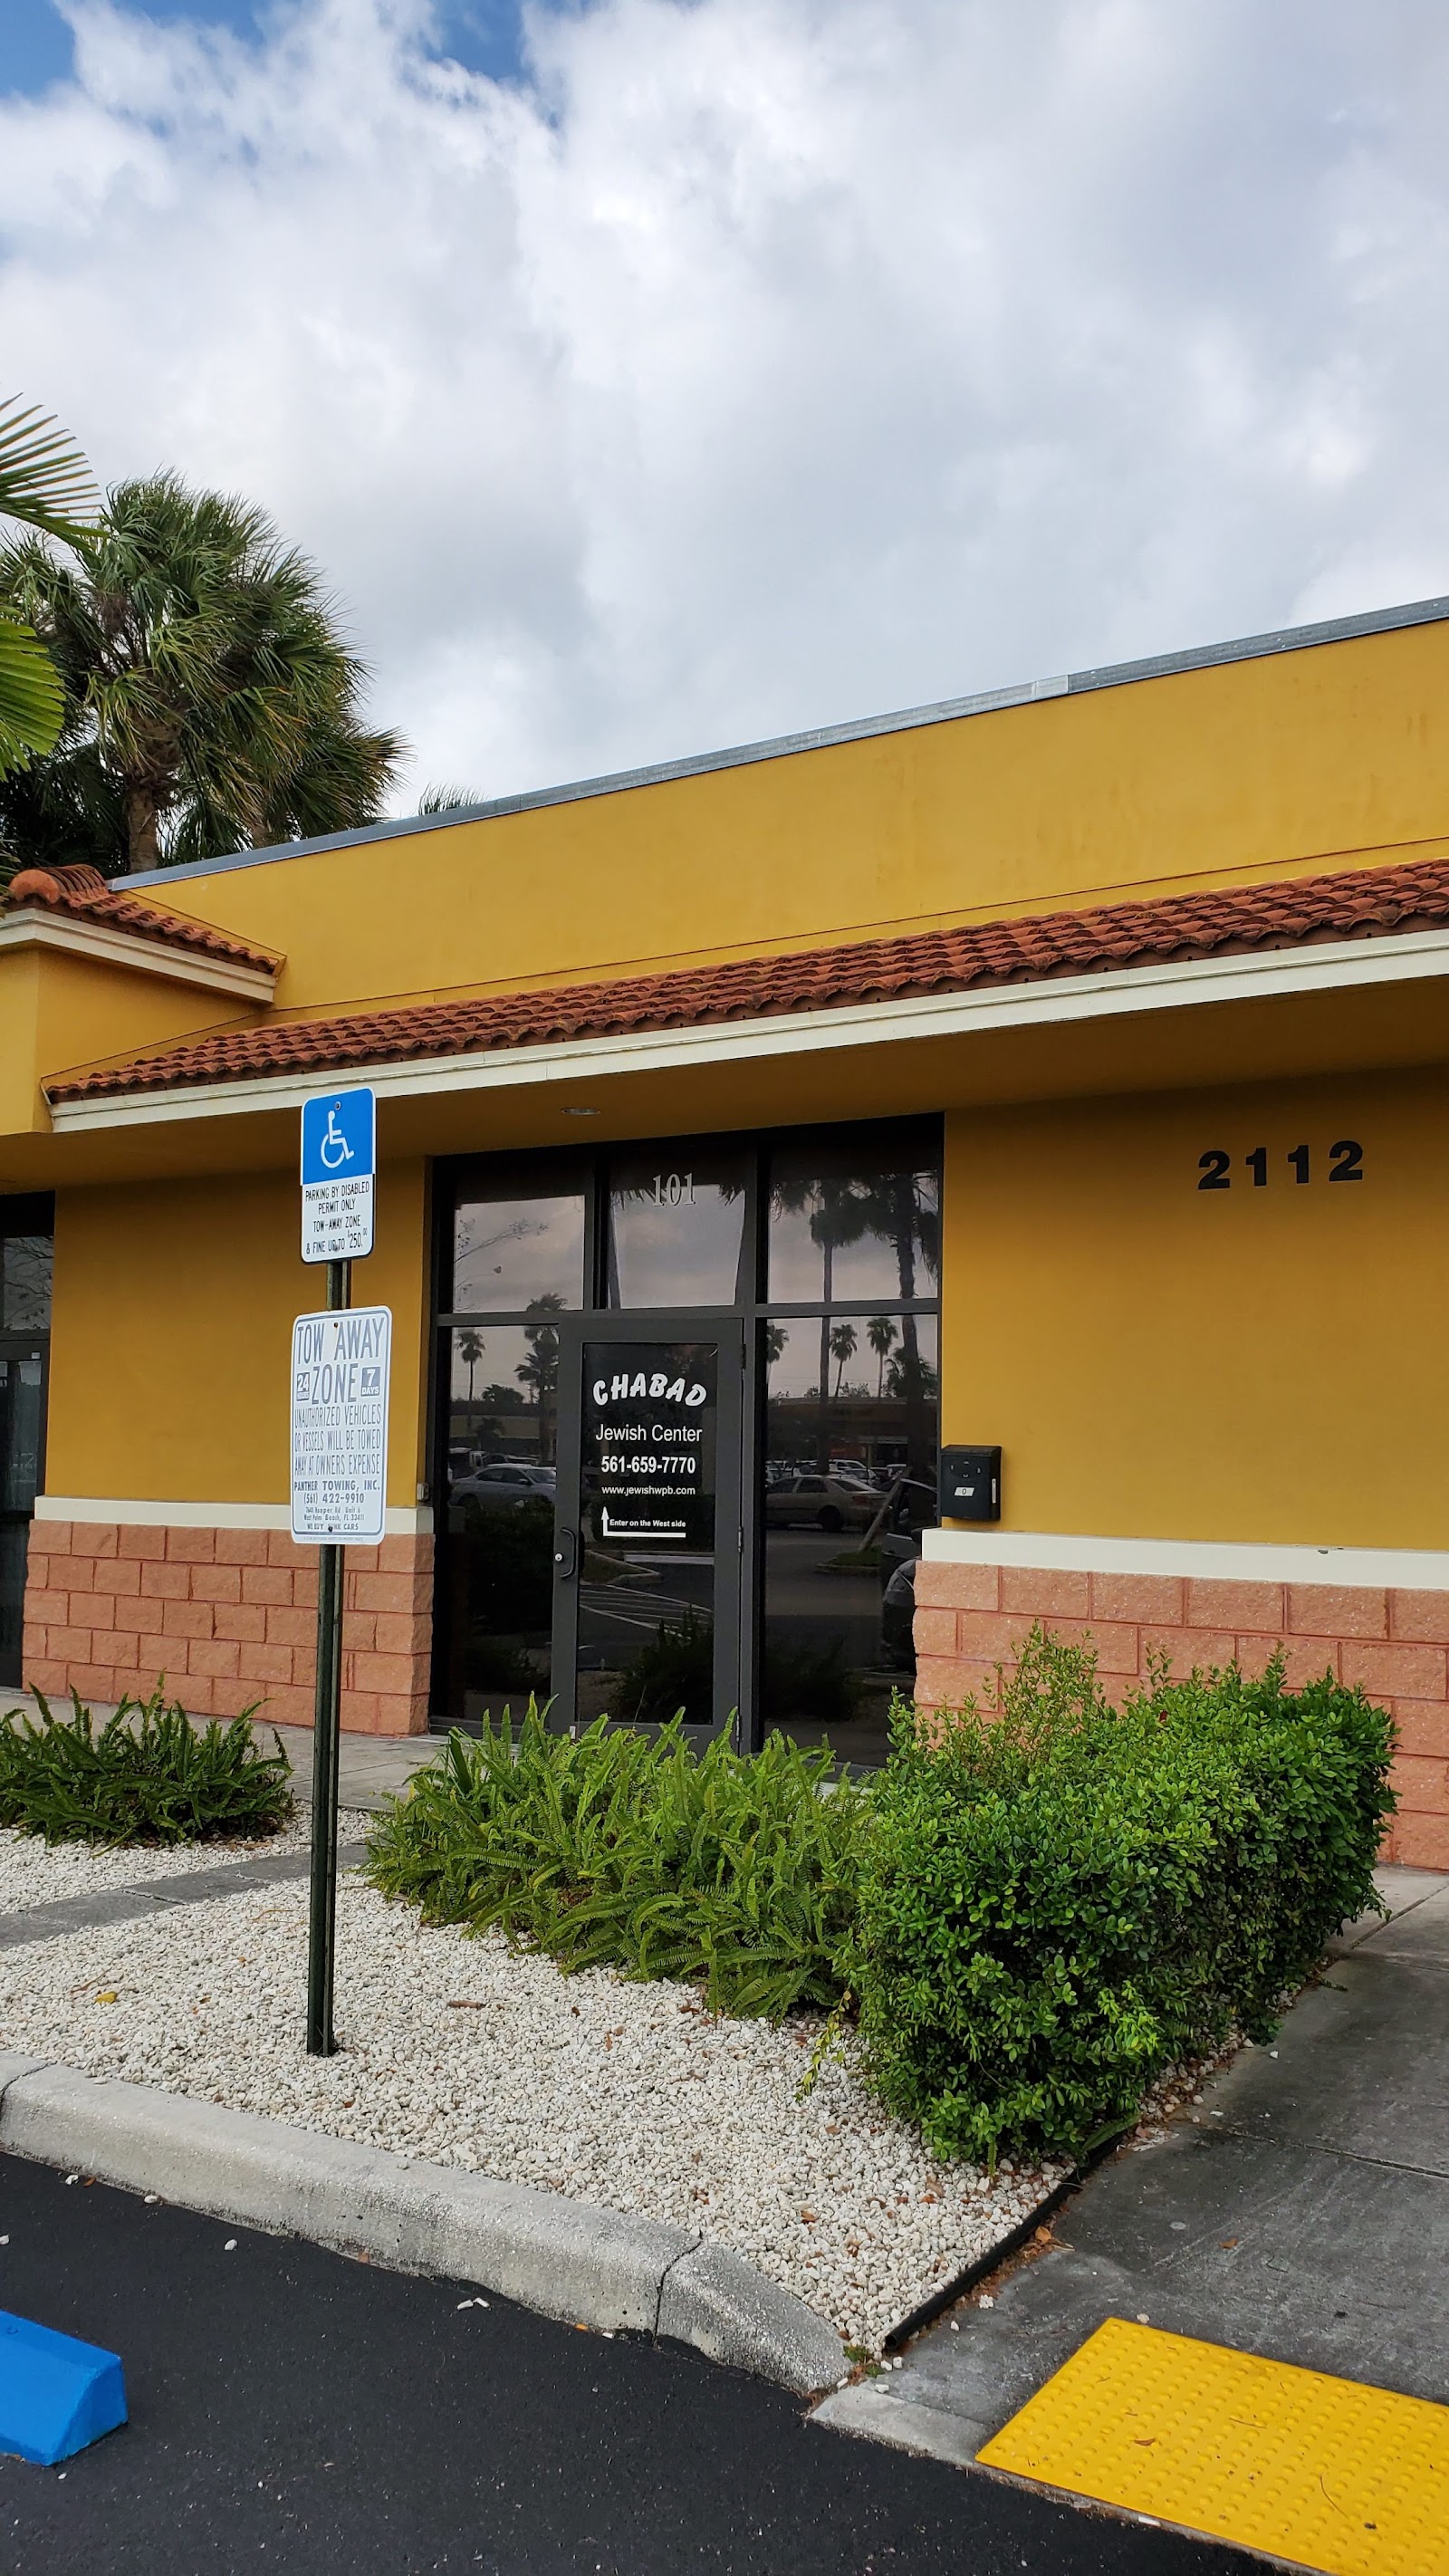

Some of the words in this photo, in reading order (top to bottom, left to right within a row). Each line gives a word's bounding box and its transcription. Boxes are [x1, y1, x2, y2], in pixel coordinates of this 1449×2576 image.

[1198, 1139, 1363, 1190] 2112
[305, 1187, 329, 1202] PARKING
[331, 1187, 339, 1198] BY
[341, 1181, 369, 1197] DISABLED
[652, 1172, 696, 1207] 101
[318, 1201, 339, 1215] PERMIT
[341, 1198, 356, 1212] ONLY
[313, 1218, 343, 1233] TOW-AWAY
[345, 1216, 361, 1228] ZONE
[312, 1241, 326, 1254] FINE
[338, 1238, 345, 1250] TO
[297, 1323, 325, 1365] TOW
[333, 1318, 385, 1361] AWAY
[297, 1375, 310, 1392] 24
[312, 1363, 360, 1405] ZONE
[367, 1370, 376, 1387] 7
[361, 1387, 379, 1396] DAYS
[593, 1372, 706, 1406] CHABAD
[294, 1407, 341, 1429] UNAUTHORIZED
[344, 1404, 381, 1426] VEHICLES
[294, 1433, 302, 1453] OR
[302, 1431, 324, 1452] VESSELS
[327, 1430, 343, 1451] WILL
[346, 1430, 355, 1450] BE
[357, 1429, 381, 1450] TOWED
[596, 1424, 647, 1441] Jewish
[651, 1425, 703, 1442] Center
[315, 1455, 345, 1475] OWNERS
[349, 1454, 380, 1475] EXPENSE
[600, 1456, 696, 1474] 561-659-7770
[294, 1481, 319, 1492] PANTHER
[322, 1480, 360, 1493] TOWING,
[364, 1480, 380, 1491] INC.
[601, 1485, 696, 1496] www.jewishwpb.com
[303, 1494, 319, 1504] (561)
[322, 1493, 365, 1504] 422-9910
[343, 1523, 360, 1531] CARS
[671, 1520, 686, 1528] side
